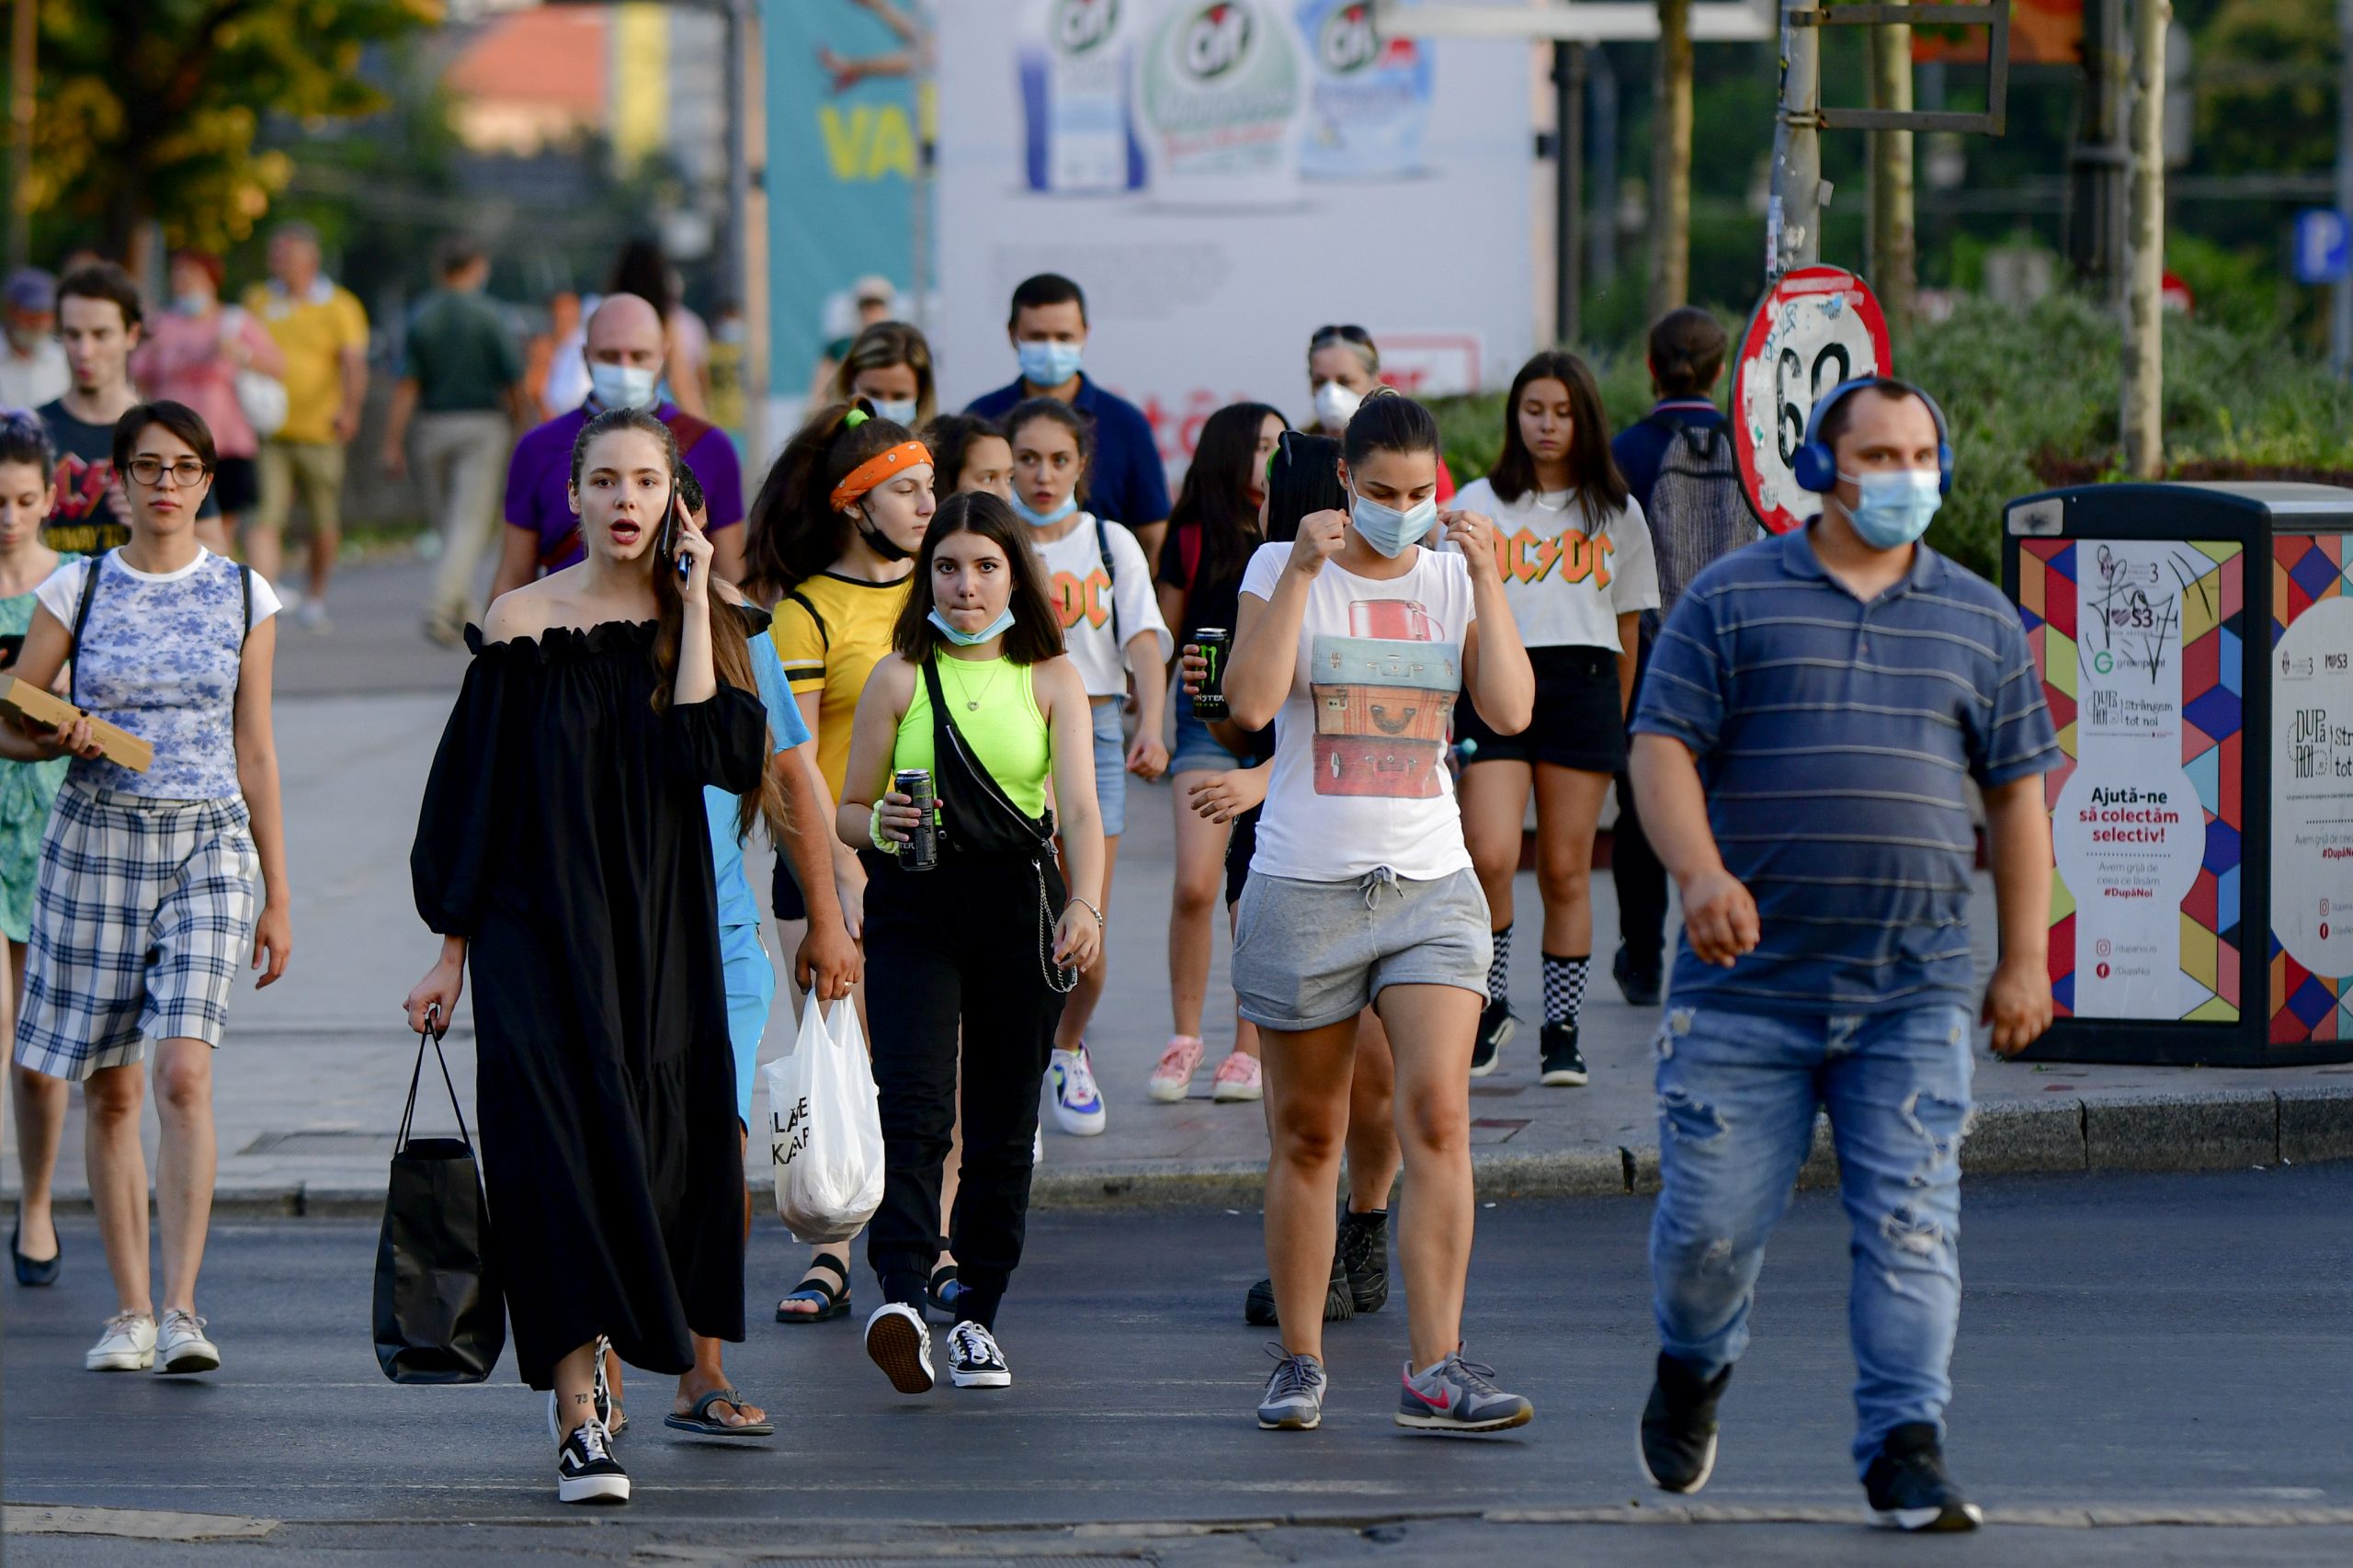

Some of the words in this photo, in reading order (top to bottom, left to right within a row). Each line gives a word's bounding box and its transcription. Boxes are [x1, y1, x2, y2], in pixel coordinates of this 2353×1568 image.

[2302, 212, 2342, 275] P
[2131, 608, 2154, 628] S3
[1195, 694, 1224, 702] NSTER
[2125, 715, 2139, 726] tot
[2336, 756, 2352, 778] tot
[2091, 787, 2167, 807] Ajută-ne
[2079, 806, 2097, 823] să
[2101, 807, 2179, 824] colectăm
[2093, 826, 2165, 843] selectiv!
[2295, 835, 2314, 846] Avem
[2329, 834, 2338, 845] de
[2098, 861, 2125, 872] Avem
[2147, 862, 2158, 872] de
[2097, 877, 2120, 885] ceea
[2120, 877, 2130, 885] ce
[574, 1392, 588, 1404] 73
